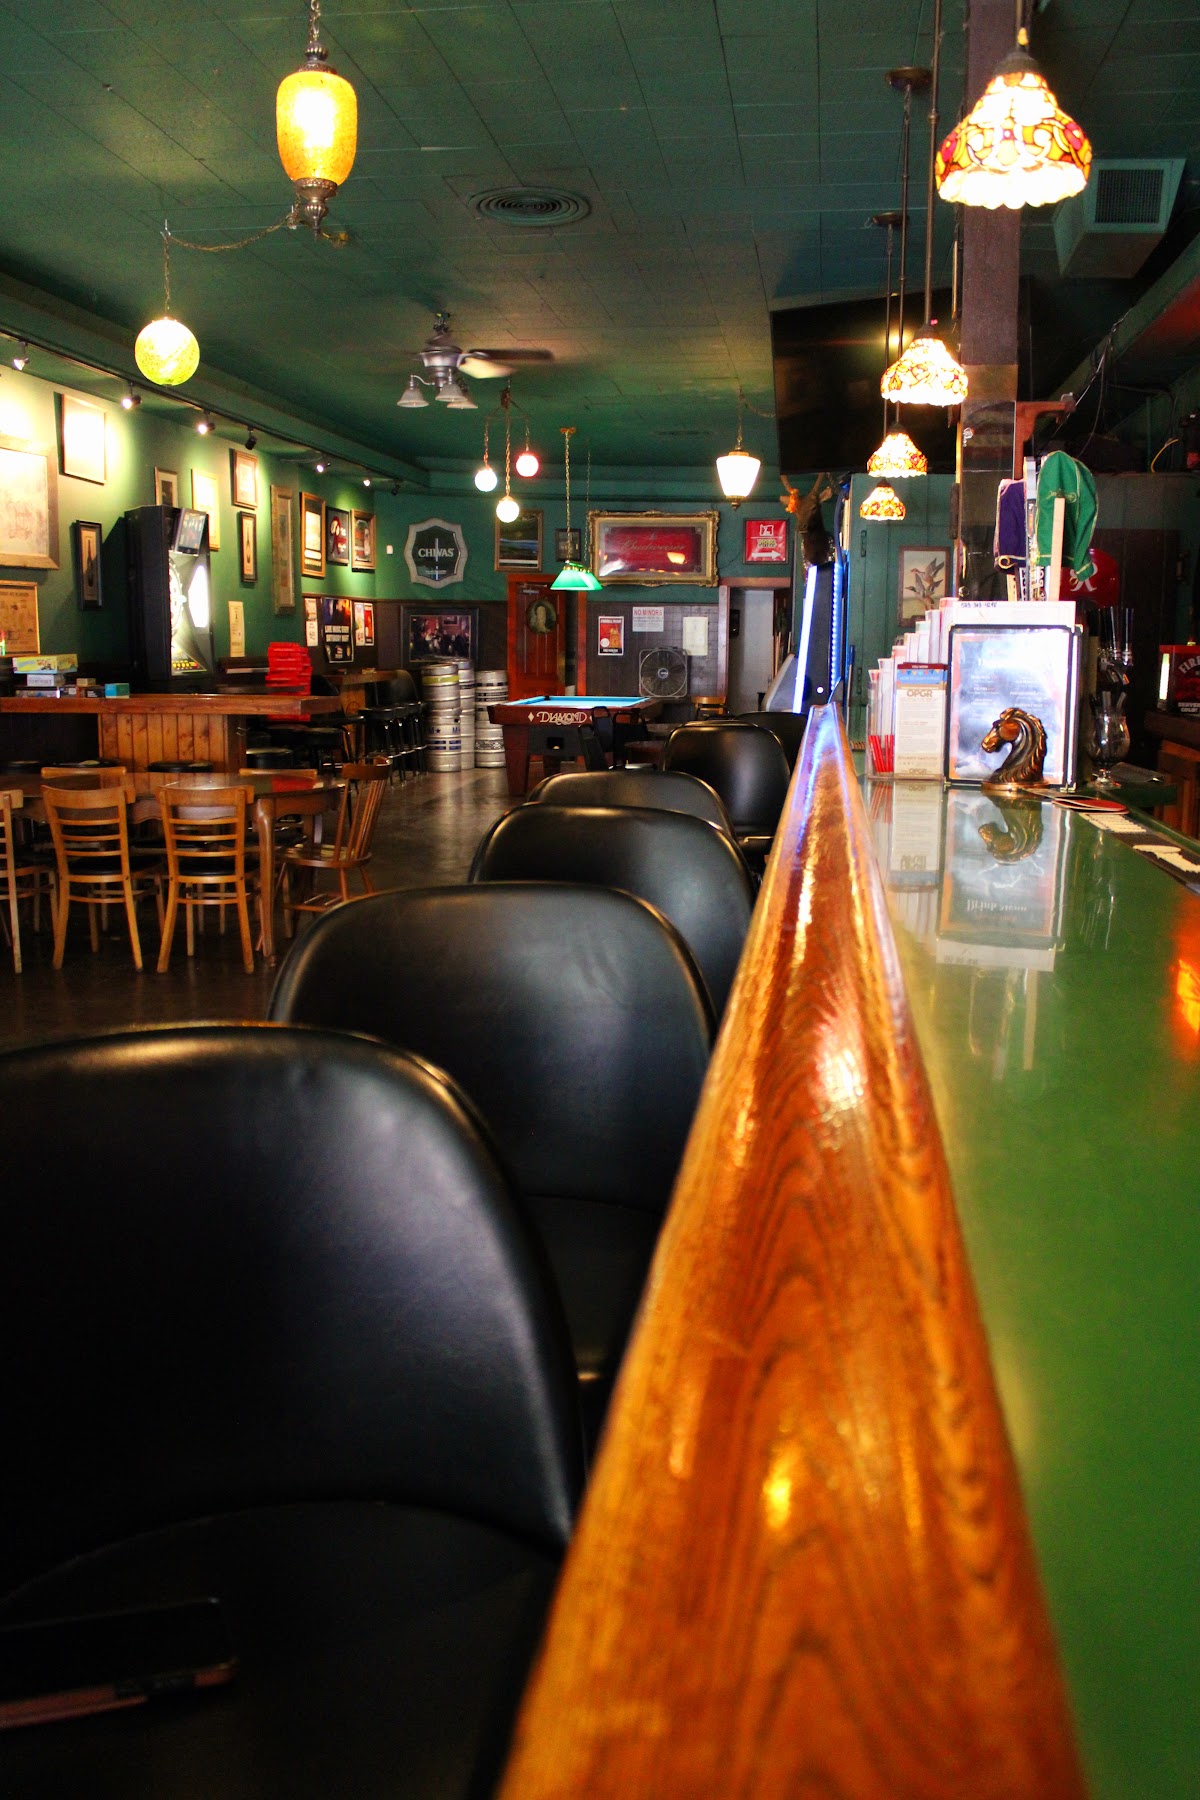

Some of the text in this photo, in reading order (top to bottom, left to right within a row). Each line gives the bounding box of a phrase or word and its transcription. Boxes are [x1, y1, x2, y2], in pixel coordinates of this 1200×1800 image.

[418, 548, 454, 557] CHIVAS
[907, 689, 932, 697] OPGR
[537, 711, 587, 725] DIAMOND
